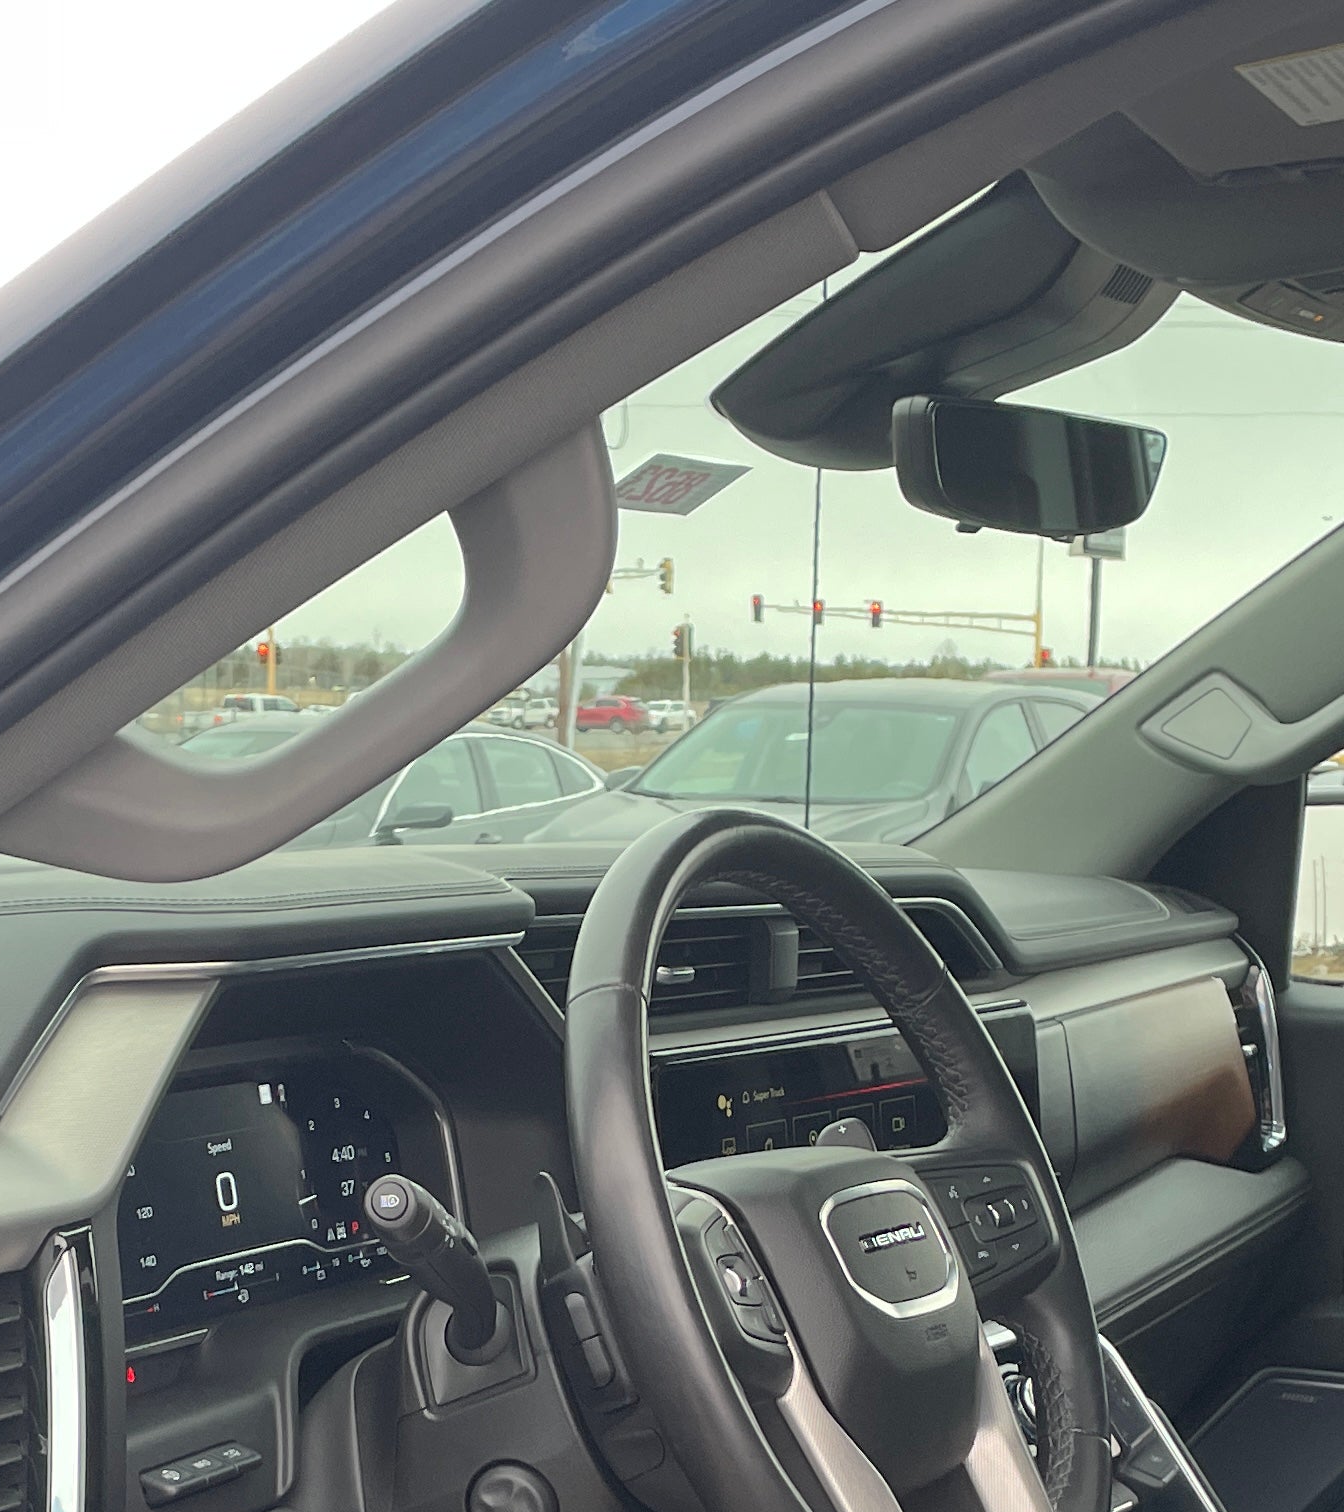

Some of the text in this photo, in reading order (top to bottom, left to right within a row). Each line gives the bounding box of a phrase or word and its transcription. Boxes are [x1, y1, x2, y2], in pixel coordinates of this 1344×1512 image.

[308, 1120, 315, 1131] 2
[207, 1138, 232, 1156] Speed
[332, 1145, 355, 1162] 4:40
[215, 1171, 239, 1212] 0
[341, 1179, 355, 1196] 37
[136, 1206, 154, 1220] 120
[221, 1212, 241, 1227] MPH
[861, 1223, 927, 1250] DENALI
[139, 1254, 157, 1269] 140
[239, 1262, 255, 1275] 142
